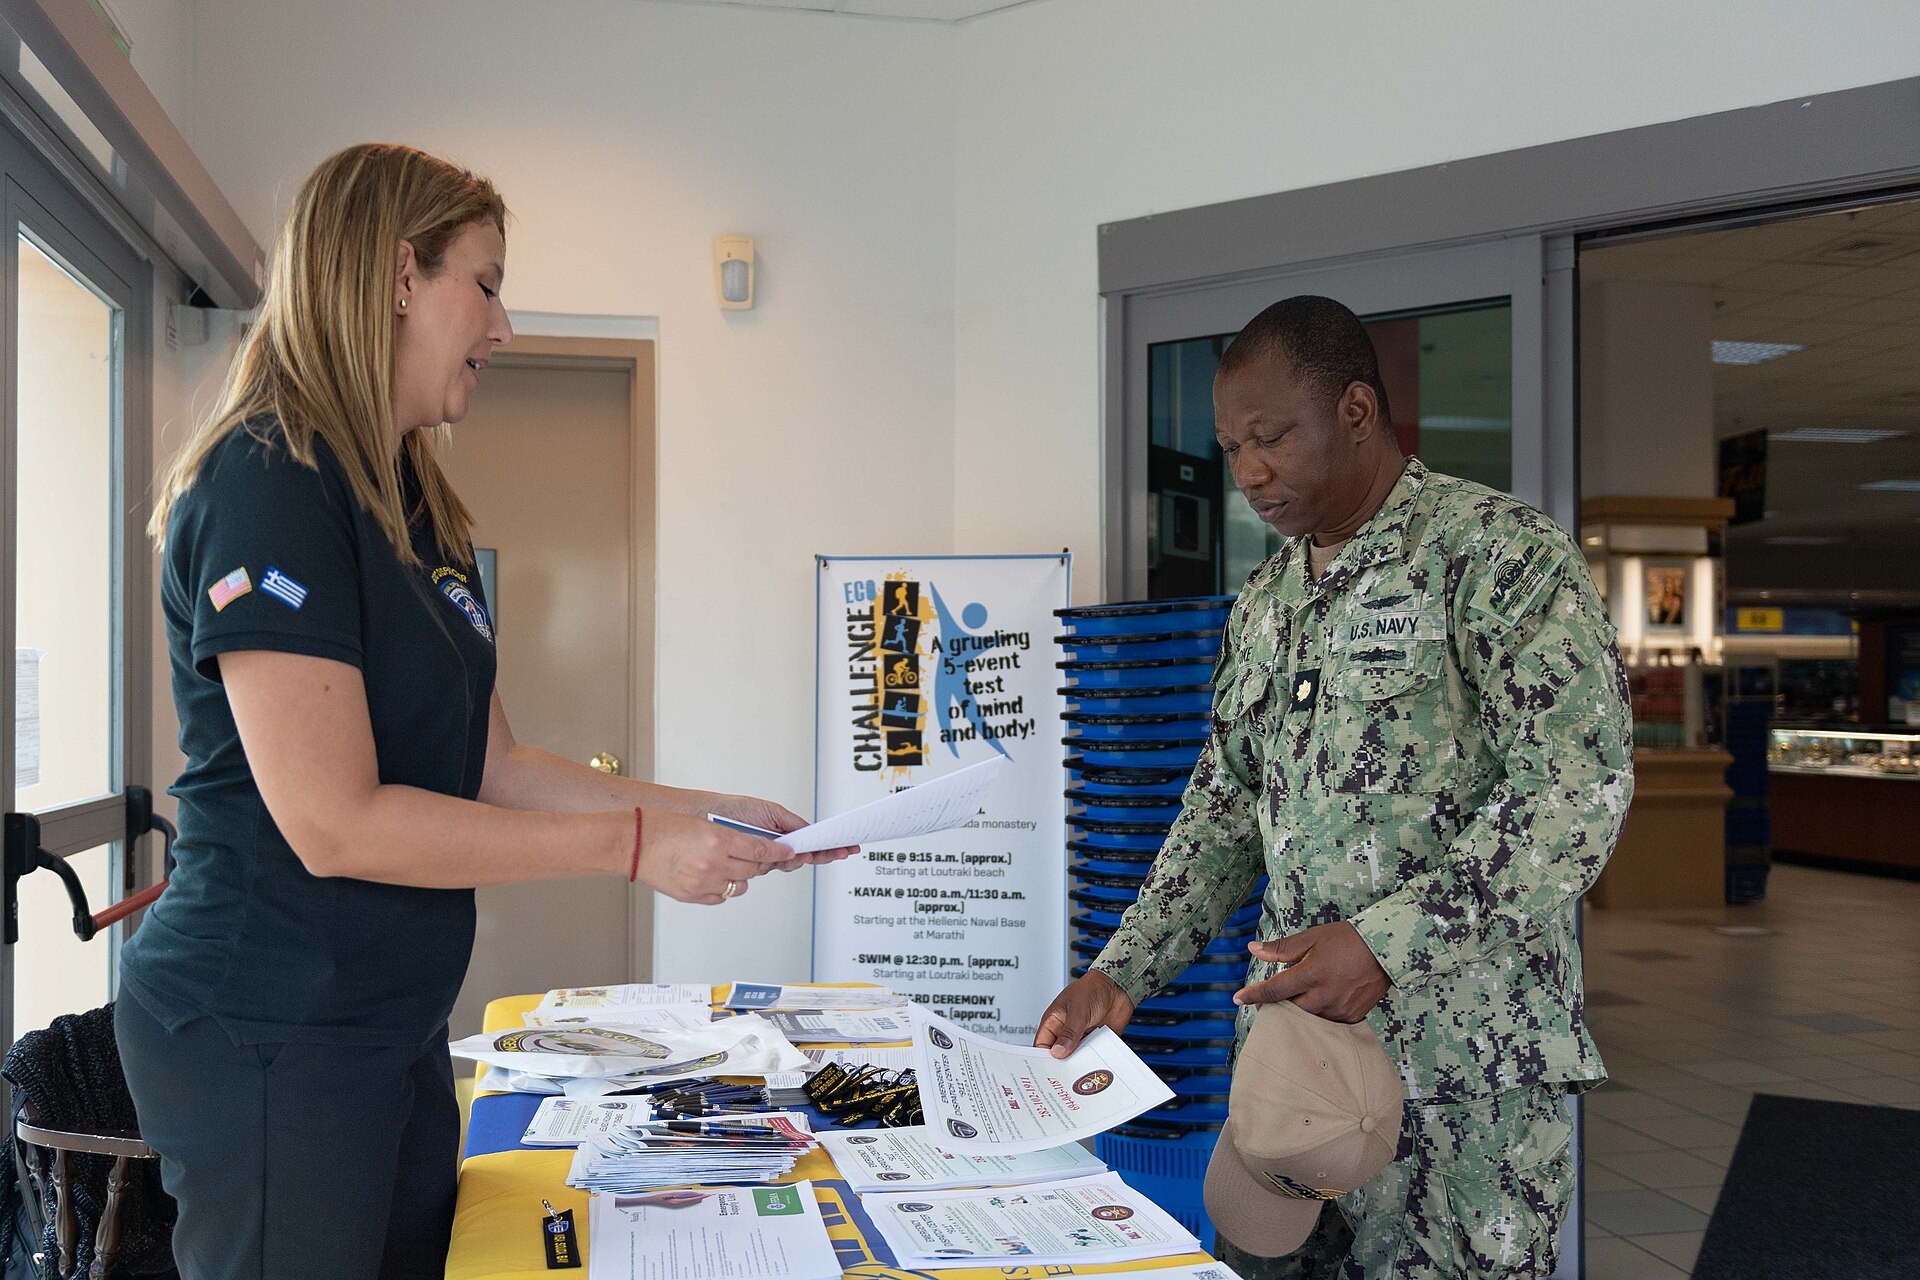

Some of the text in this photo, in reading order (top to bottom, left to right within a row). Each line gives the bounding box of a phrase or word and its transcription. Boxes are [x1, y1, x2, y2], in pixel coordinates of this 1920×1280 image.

[844, 580, 876, 603] ECO
[1350, 617, 1419, 641] U.S. NAVY
[931, 630, 1030, 657] A grueling
[944, 652, 1020, 675] 5-event
[847, 605, 882, 771] CHALLENGE
[963, 676, 1005, 696] test
[948, 696, 1023, 719] of mind
[940, 718, 1036, 743] and body!
[982, 820, 1037, 831] monastery
[869, 852, 894, 862] BIKE
[896, 853, 906, 863] @
[909, 852, 932, 862] 9:15
[935, 854, 959, 863] a.m.
[875, 866, 1005, 878] Starting at Loutraki beach
[854, 887, 892, 897] KAYAK
[894, 888, 905, 898] @
[907, 888, 938, 898] 10:00
[940, 888, 999, 900] a.m./11:30
[1001, 891, 1026, 900] a.m.
[854, 915, 1026, 928] Starting at the Hellenic Naval Base
[914, 930, 965, 940] at Marathi
[858, 954, 891, 964] SWIM
[893, 955, 904, 965] @
[906, 955, 937, 965] 12:30
[940, 956, 964, 967] p.m.
[873, 969, 1003, 981] Starting at Loutraki beach
[932, 994, 995, 1005] CEREMONY
[971, 1023, 997, 1035] Club,
[1000, 1024, 1036, 1035] Marathi
[932, 1060, 949, 1103] EMERGENCY
[940, 1054, 962, 1116] DISPATCH CENTER
[718, 1193, 728, 1216] Emergency
[729, 1202, 740, 1216] Supply
